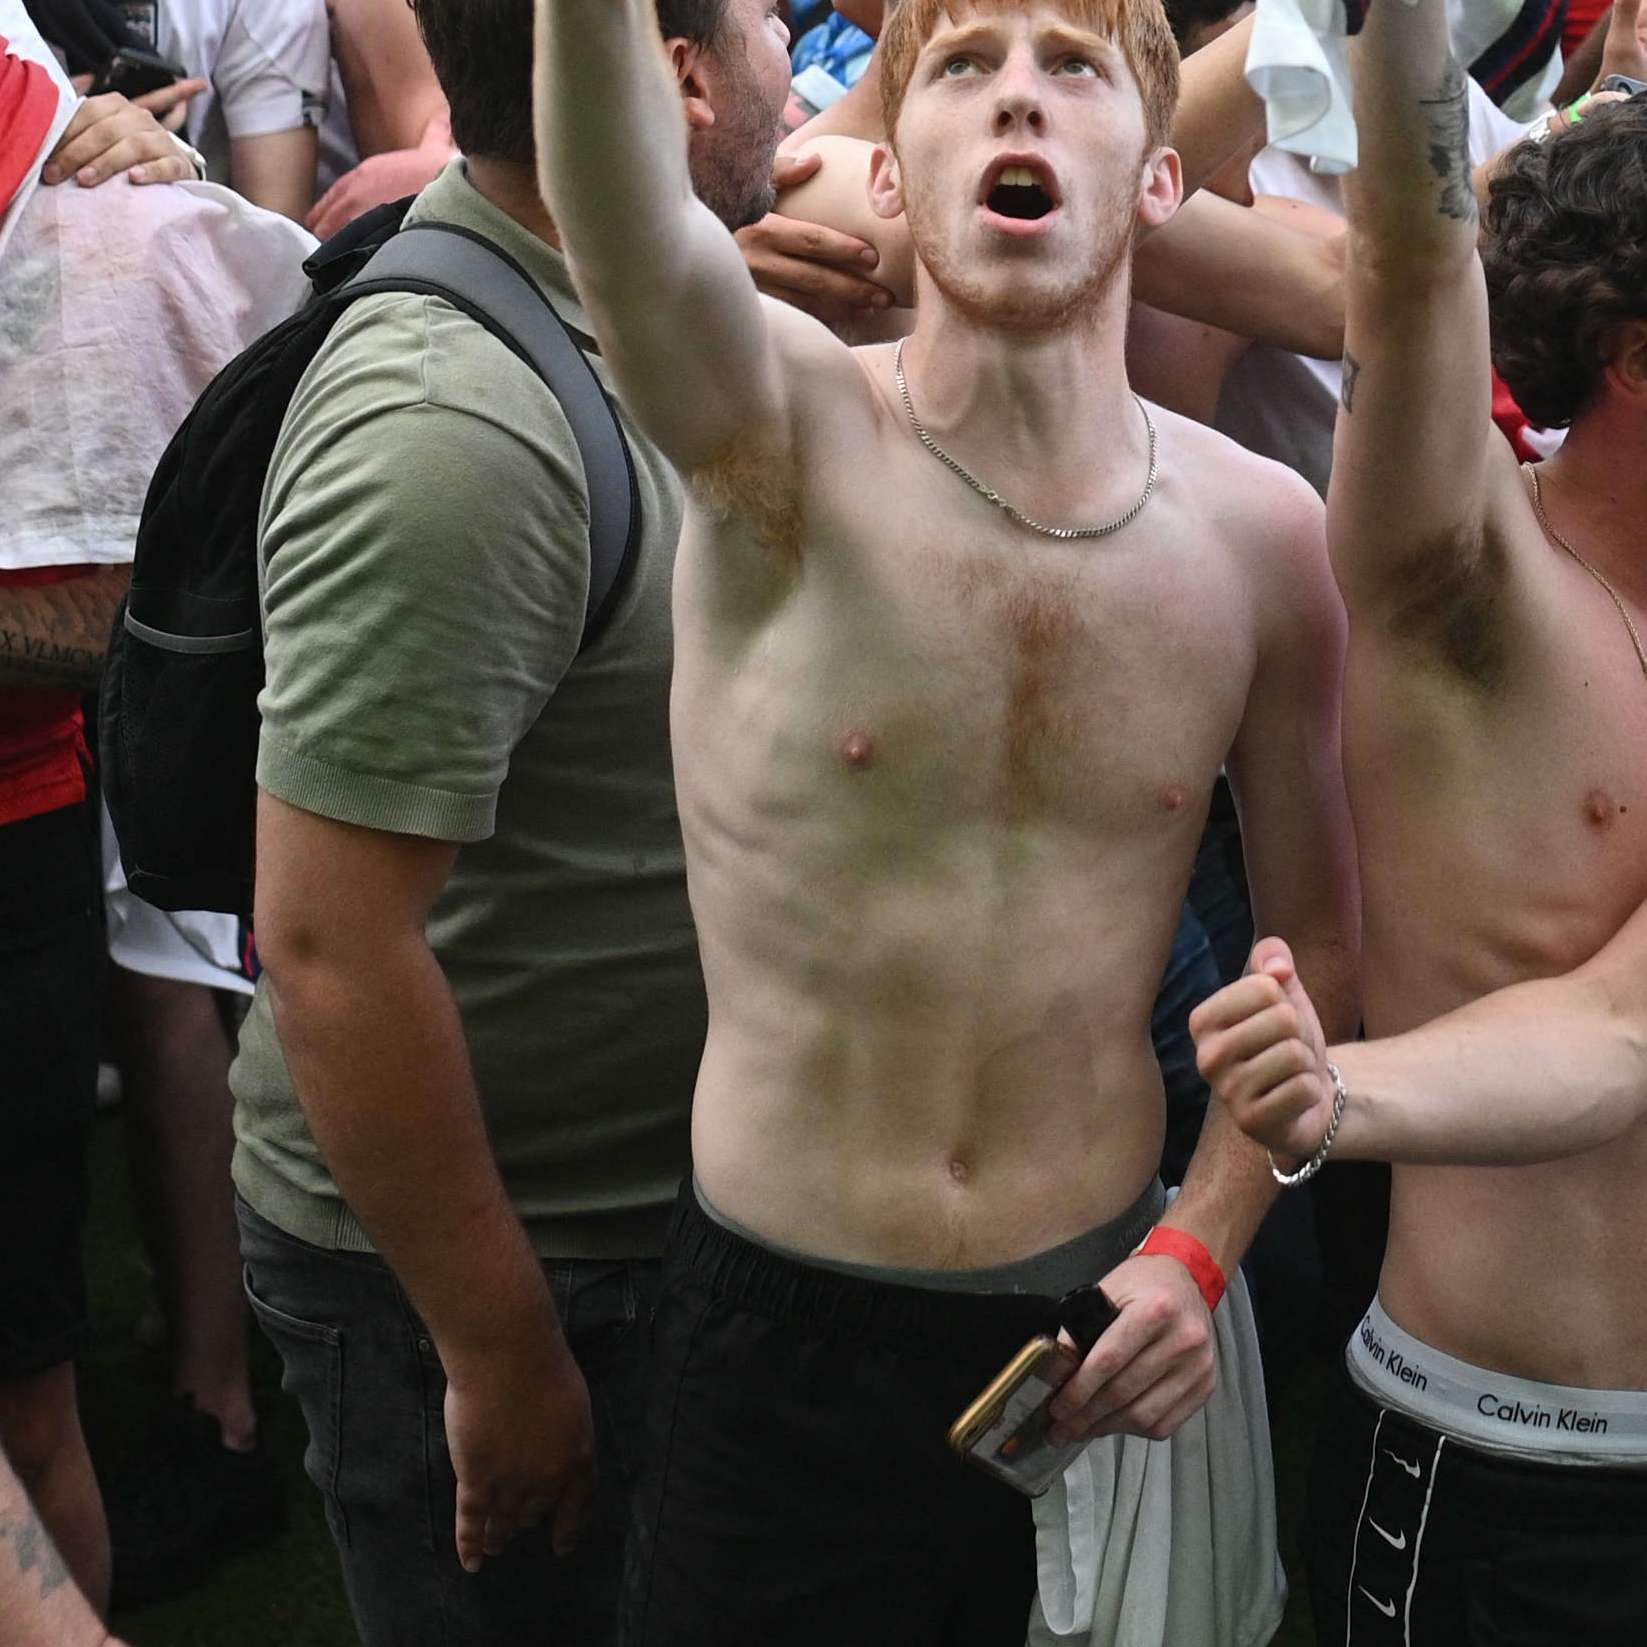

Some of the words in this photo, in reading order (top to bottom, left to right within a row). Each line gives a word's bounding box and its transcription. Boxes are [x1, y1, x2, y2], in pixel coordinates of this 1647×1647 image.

[1360, 1314, 1385, 1365] Calvin
[1386, 1350, 1428, 1391] Klein
[1477, 1393, 1551, 1428] Calvin
[1556, 1408, 1608, 1433] Klein
